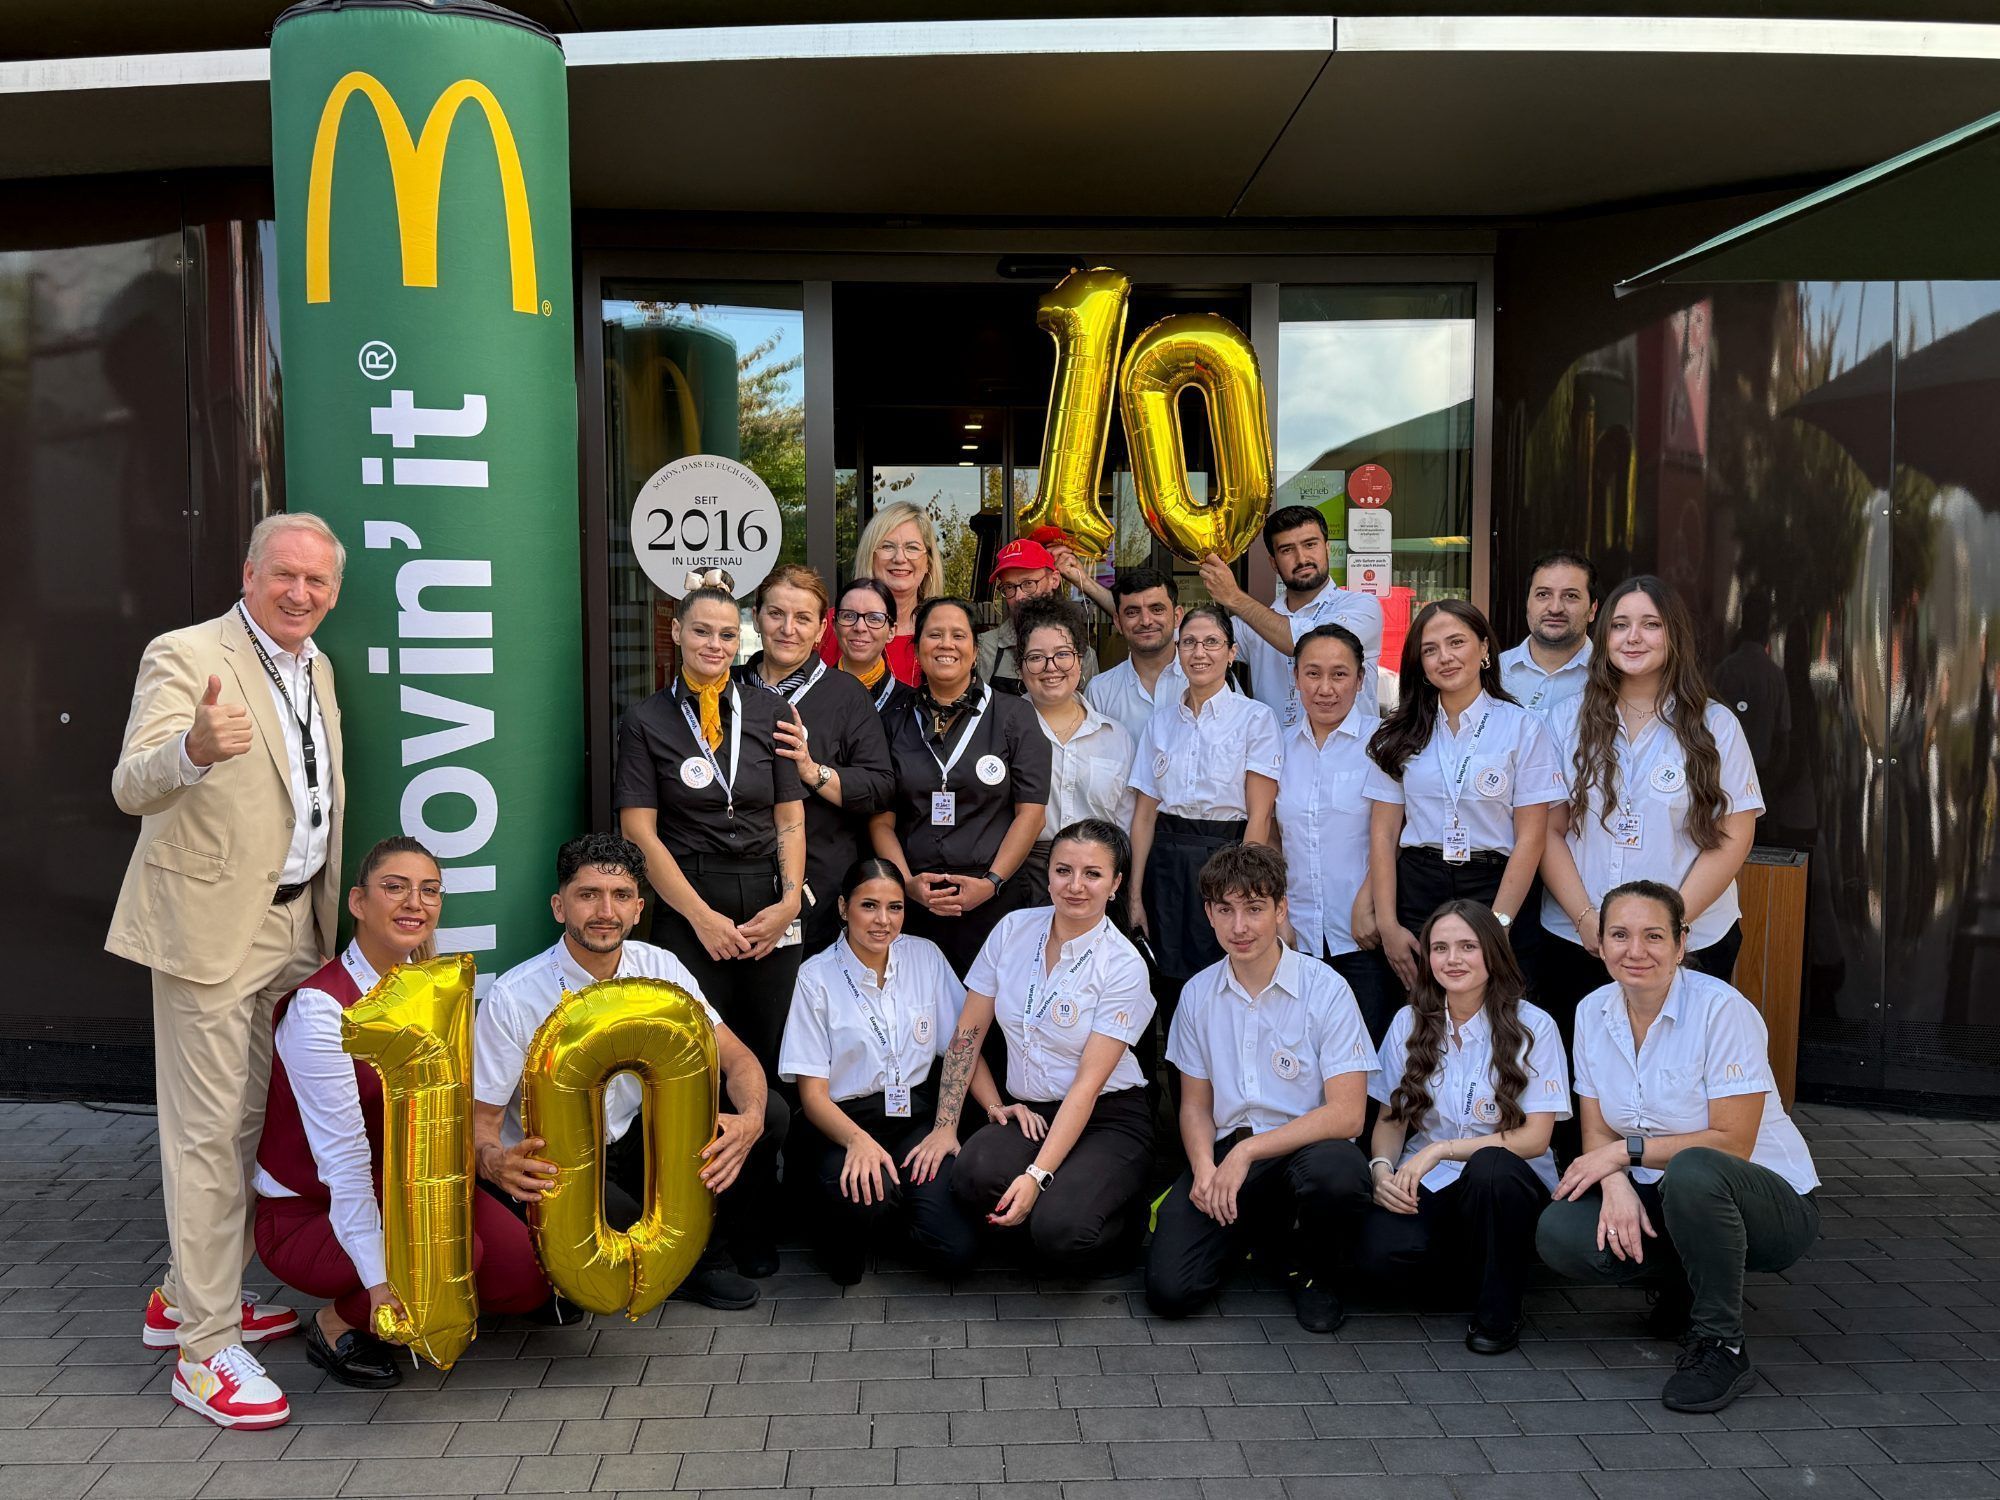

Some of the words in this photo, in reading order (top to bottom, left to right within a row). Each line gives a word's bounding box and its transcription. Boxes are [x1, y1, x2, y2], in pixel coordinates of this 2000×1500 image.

[1018, 266, 1274, 565] 10
[681, 461, 703, 472] DASS
[716, 462, 740, 477] EUCH
[694, 496, 718, 505] SEIT
[647, 508, 768, 552] 2016
[672, 557, 683, 566] IN
[686, 557, 743, 566] LUSTENAU
[691, 765, 702, 775] 10
[988, 762, 998, 774] 10
[1488, 773, 1499, 784] 10
[1663, 769, 1676, 780] 10
[1069, 948, 1093, 974] Vorarlberg
[844, 969, 860, 999] Vorarlberg
[1035, 991, 1058, 1019] Vorarlberg
[1060, 1004, 1070, 1013] 10
[869, 1016, 887, 1046] Vorarlberg
[920, 1021, 928, 1030] 10
[1280, 1057, 1291, 1067] 10
[1464, 1081, 1477, 1116] Vorarlberg
[1485, 1103, 1496, 1111] 10
[341, 952, 721, 1371] 10
